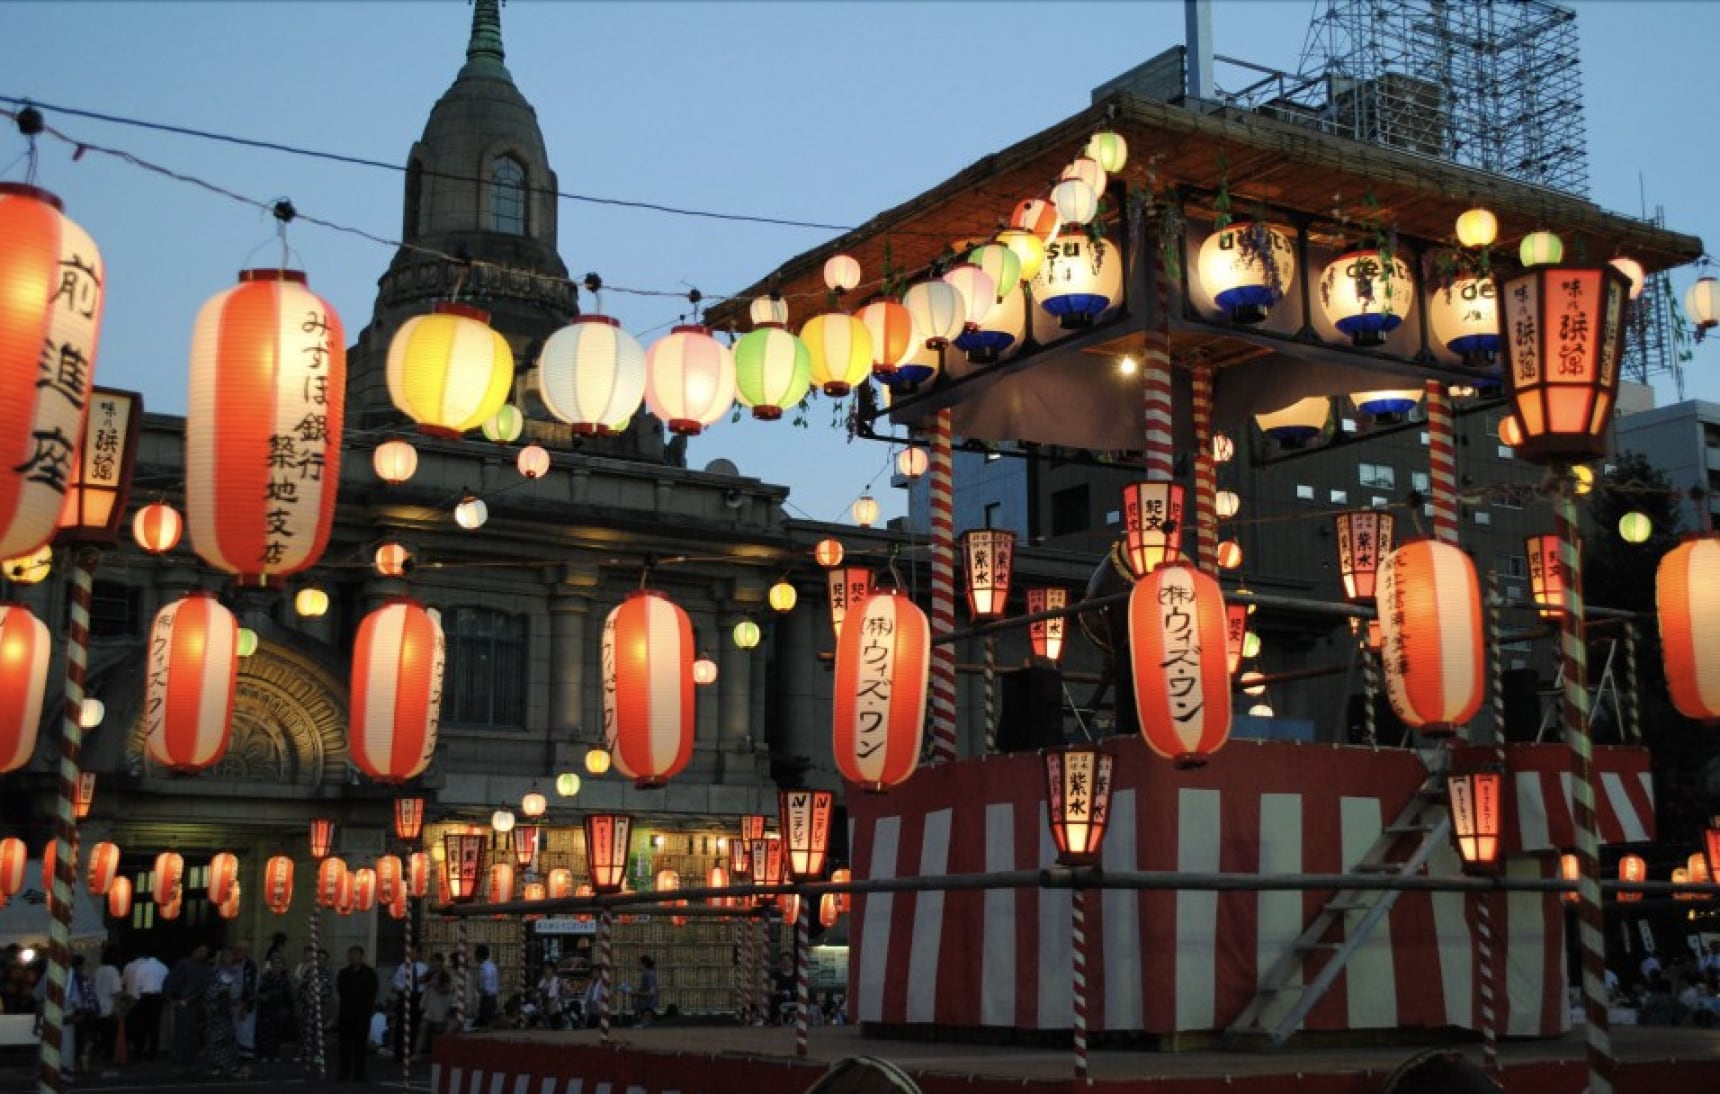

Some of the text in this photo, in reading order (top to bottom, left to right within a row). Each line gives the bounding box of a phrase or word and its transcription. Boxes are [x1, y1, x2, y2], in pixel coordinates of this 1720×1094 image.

[13, 253, 103, 496] 前進座
[294, 310, 336, 481] みずほ銀行
[260, 434, 298, 564] 築地支店
[1145, 500, 1163, 529] 紀文
[974, 549, 989, 585] 紫水
[1357, 531, 1372, 567] 紫水
[833, 583, 844, 608] 紀文
[1069, 772, 1088, 816] 紫水
